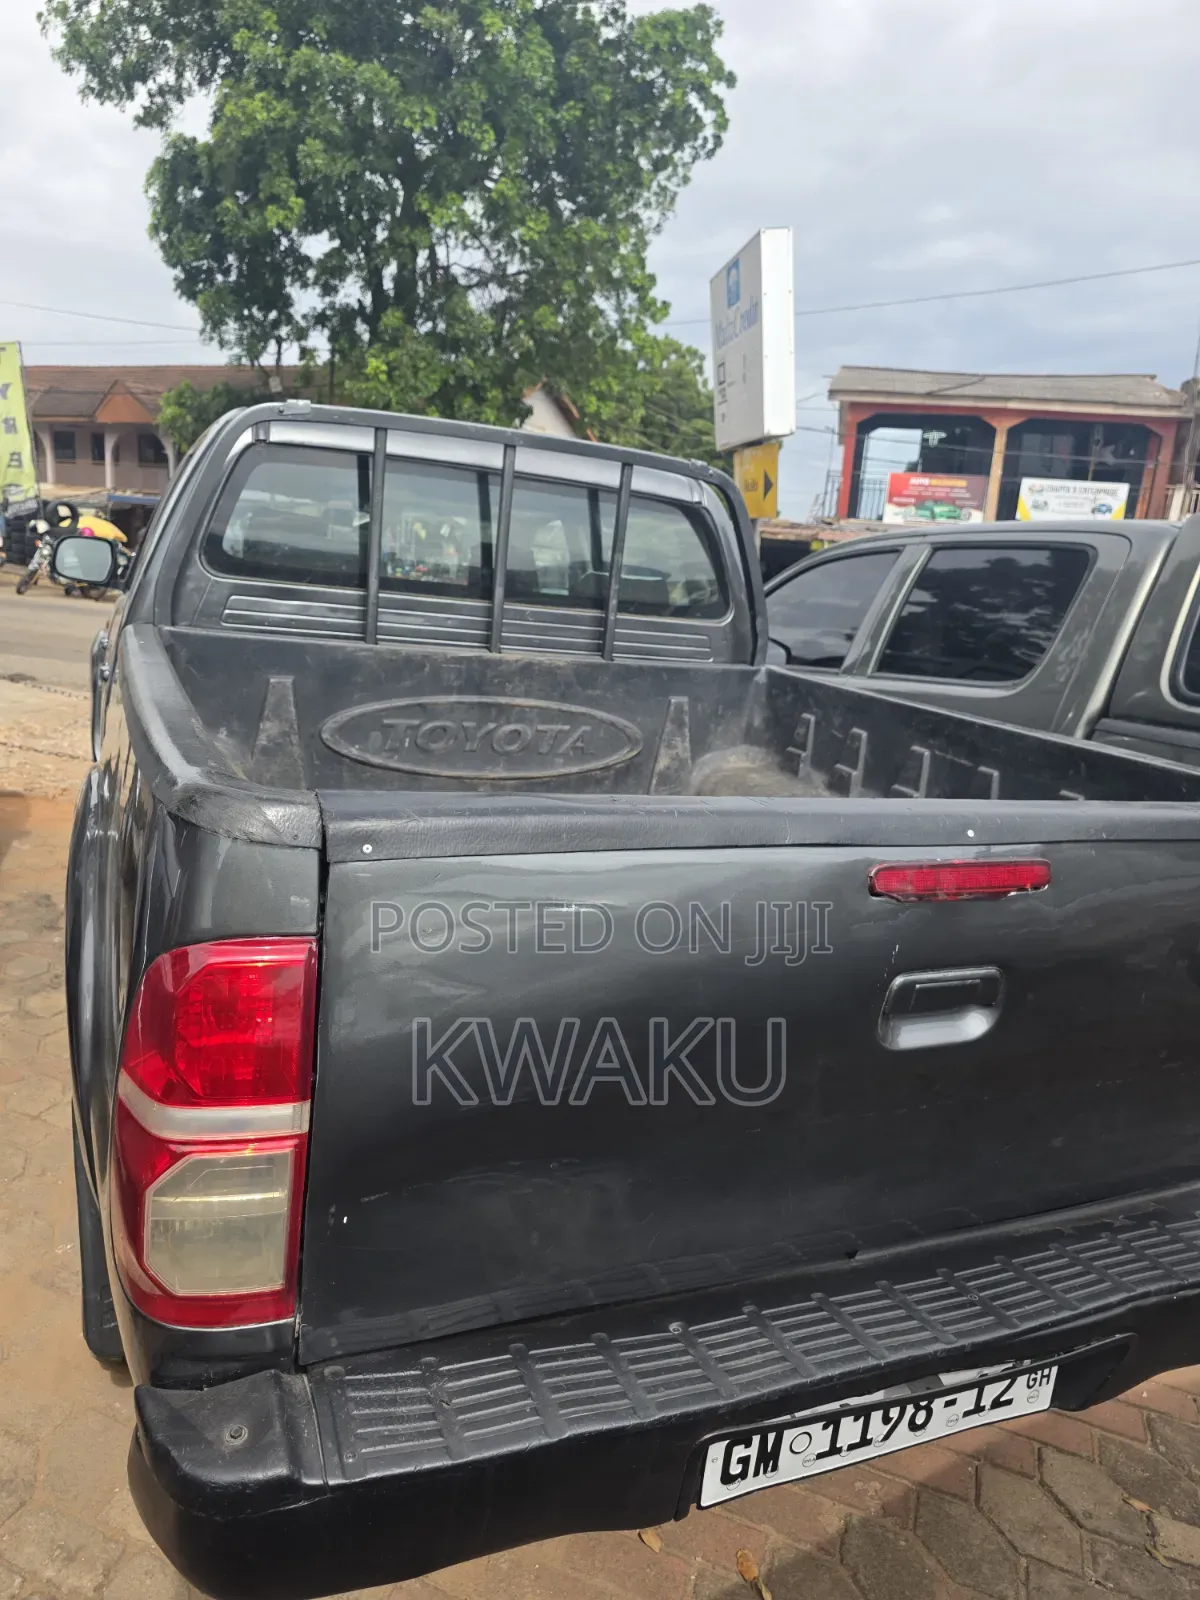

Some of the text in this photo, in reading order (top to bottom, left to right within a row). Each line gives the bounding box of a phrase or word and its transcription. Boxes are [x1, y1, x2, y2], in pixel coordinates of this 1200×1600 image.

[381, 718, 596, 756] TOYOTA
[1026, 1367, 1051, 1390] GH
[720, 1429, 785, 1486] GM
